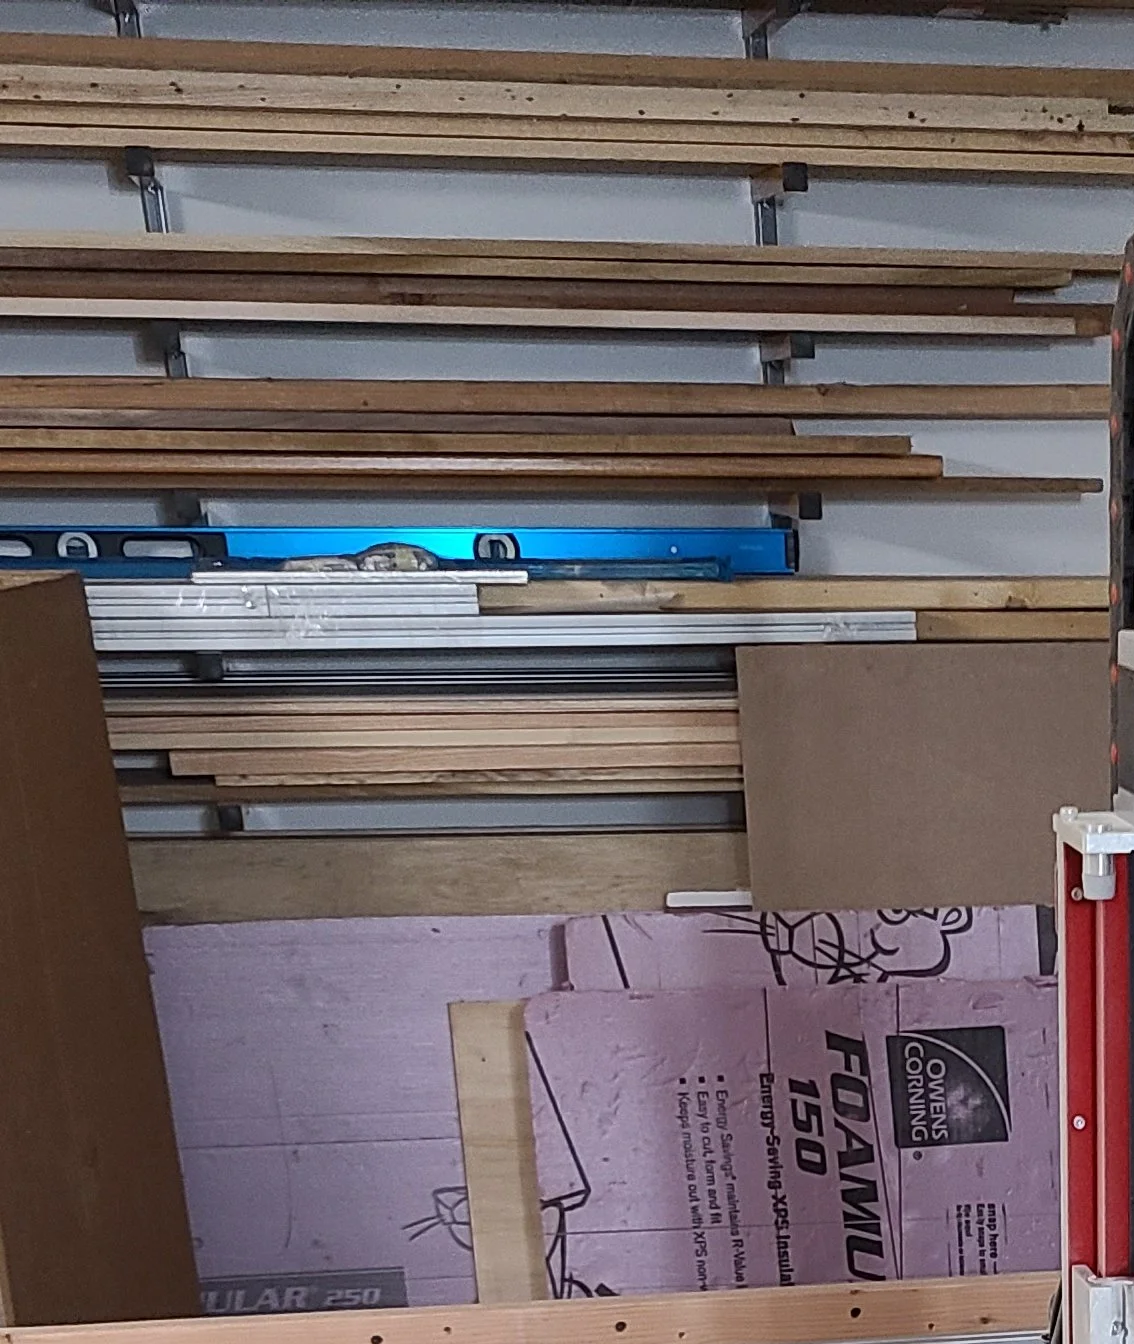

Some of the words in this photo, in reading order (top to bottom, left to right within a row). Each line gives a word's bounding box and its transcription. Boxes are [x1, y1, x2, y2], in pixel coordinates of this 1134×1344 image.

[696, 1091, 710, 1119] Easy
[904, 1041, 929, 1142] CORNING
[926, 1058, 949, 1141] OWENS
[676, 1092, 692, 1128] Keeps
[715, 1090, 730, 1130] Energy
[700, 1122, 712, 1133] to
[788, 1078, 827, 1176] 150
[681, 1132, 698, 1181] moisture
[704, 1160, 717, 1186] form
[688, 1183, 701, 1203] out
[708, 1189, 720, 1210] and
[691, 1205, 704, 1229] with
[710, 1212, 722, 1225] fit
[726, 1183, 742, 1236] maintains
[771, 1194, 790, 1230] XPS
[693, 1231, 708, 1258] XPS
[731, 1239, 745, 1282] R-Value
[201, 1286, 307, 1313] ULAR
[325, 1288, 381, 1306] 250
